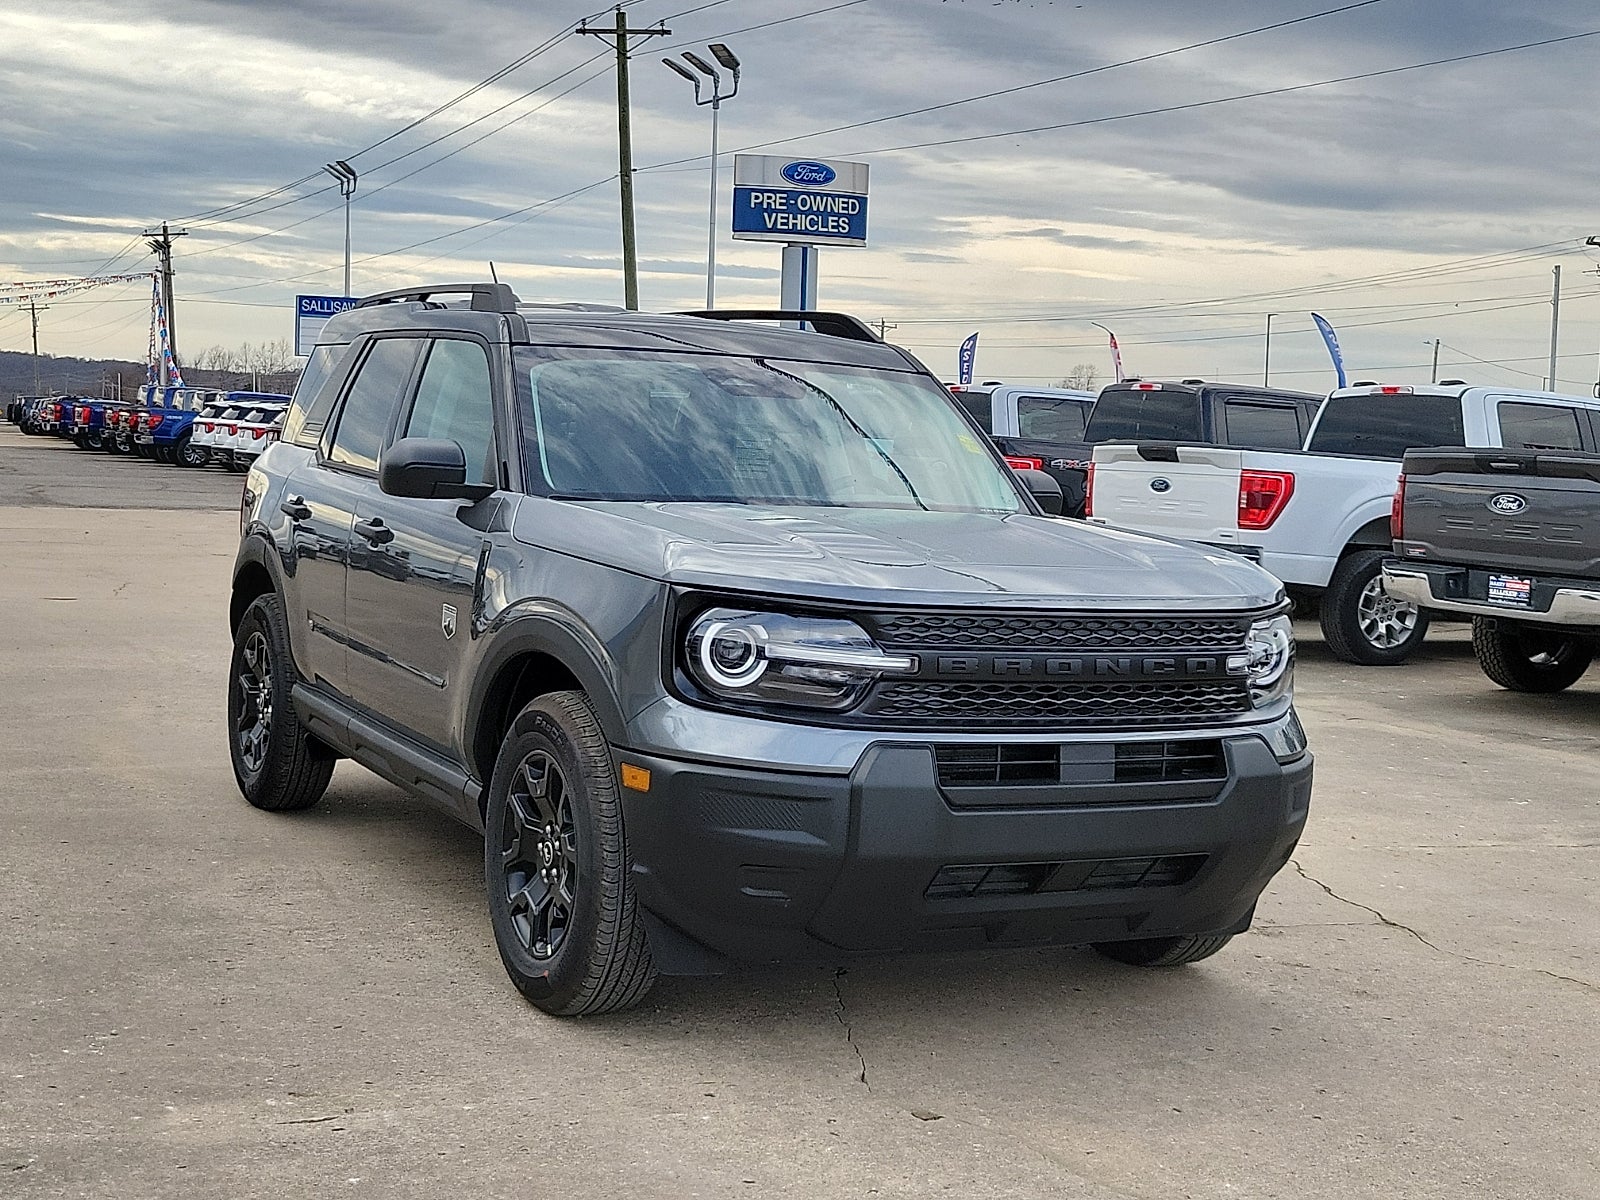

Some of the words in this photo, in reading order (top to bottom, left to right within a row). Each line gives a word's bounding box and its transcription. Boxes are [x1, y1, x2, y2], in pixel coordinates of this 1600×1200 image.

[794, 164, 826, 182] Ford
[763, 212, 850, 234] VEHICLES
[962, 340, 973, 384] USED
[937, 656, 1217, 676] BRONCO
